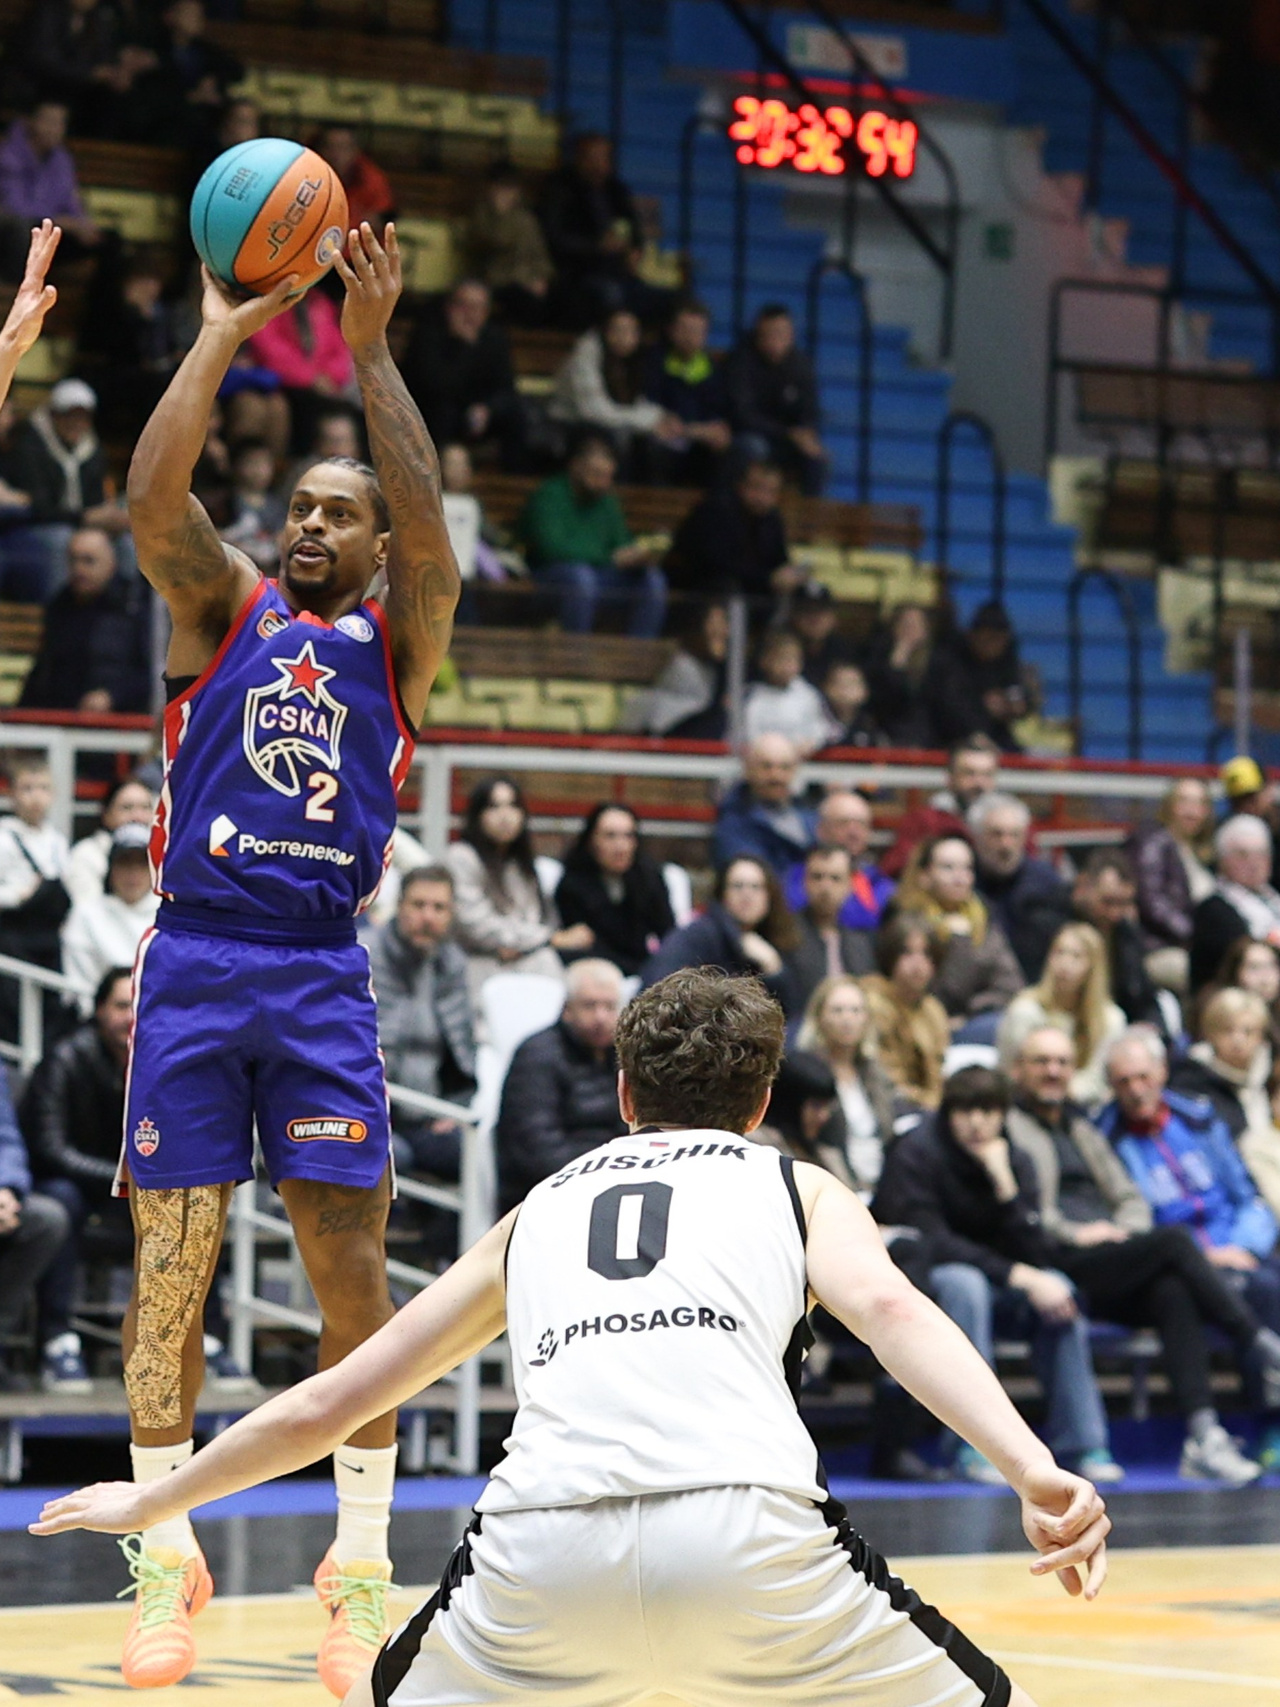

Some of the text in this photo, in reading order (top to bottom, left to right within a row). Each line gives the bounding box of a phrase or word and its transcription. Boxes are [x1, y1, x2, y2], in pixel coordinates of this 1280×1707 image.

[258, 703, 329, 741] CSKA
[304, 770, 338, 823] 2
[293, 1121, 349, 1138] WINLINE
[587, 1180, 674, 1281] 0
[564, 1306, 738, 1346] PHOSAGRO
